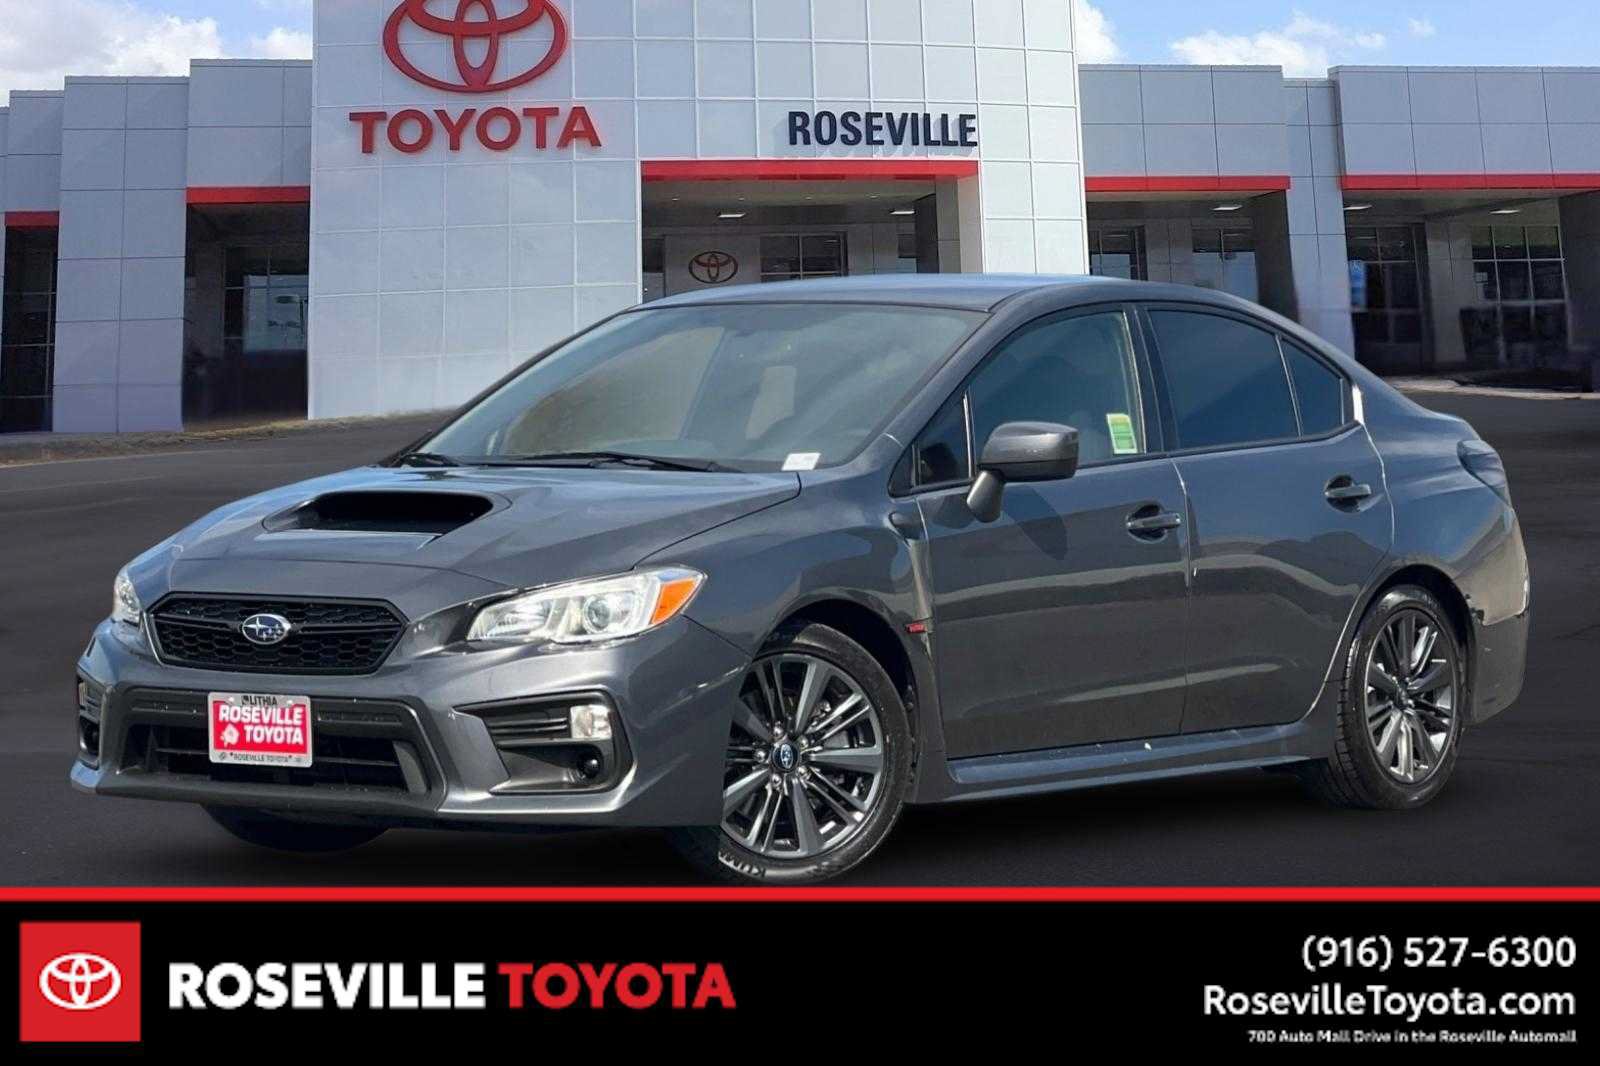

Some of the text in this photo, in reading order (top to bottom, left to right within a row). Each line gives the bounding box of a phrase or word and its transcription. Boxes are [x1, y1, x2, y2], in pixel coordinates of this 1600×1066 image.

[349, 106, 602, 153] TOYOTA
[788, 110, 978, 147] ROSEVILLE
[249, 695, 278, 706] LITHIA
[219, 704, 304, 726] ROSEVILLE
[243, 724, 304, 745] TOYOTA
